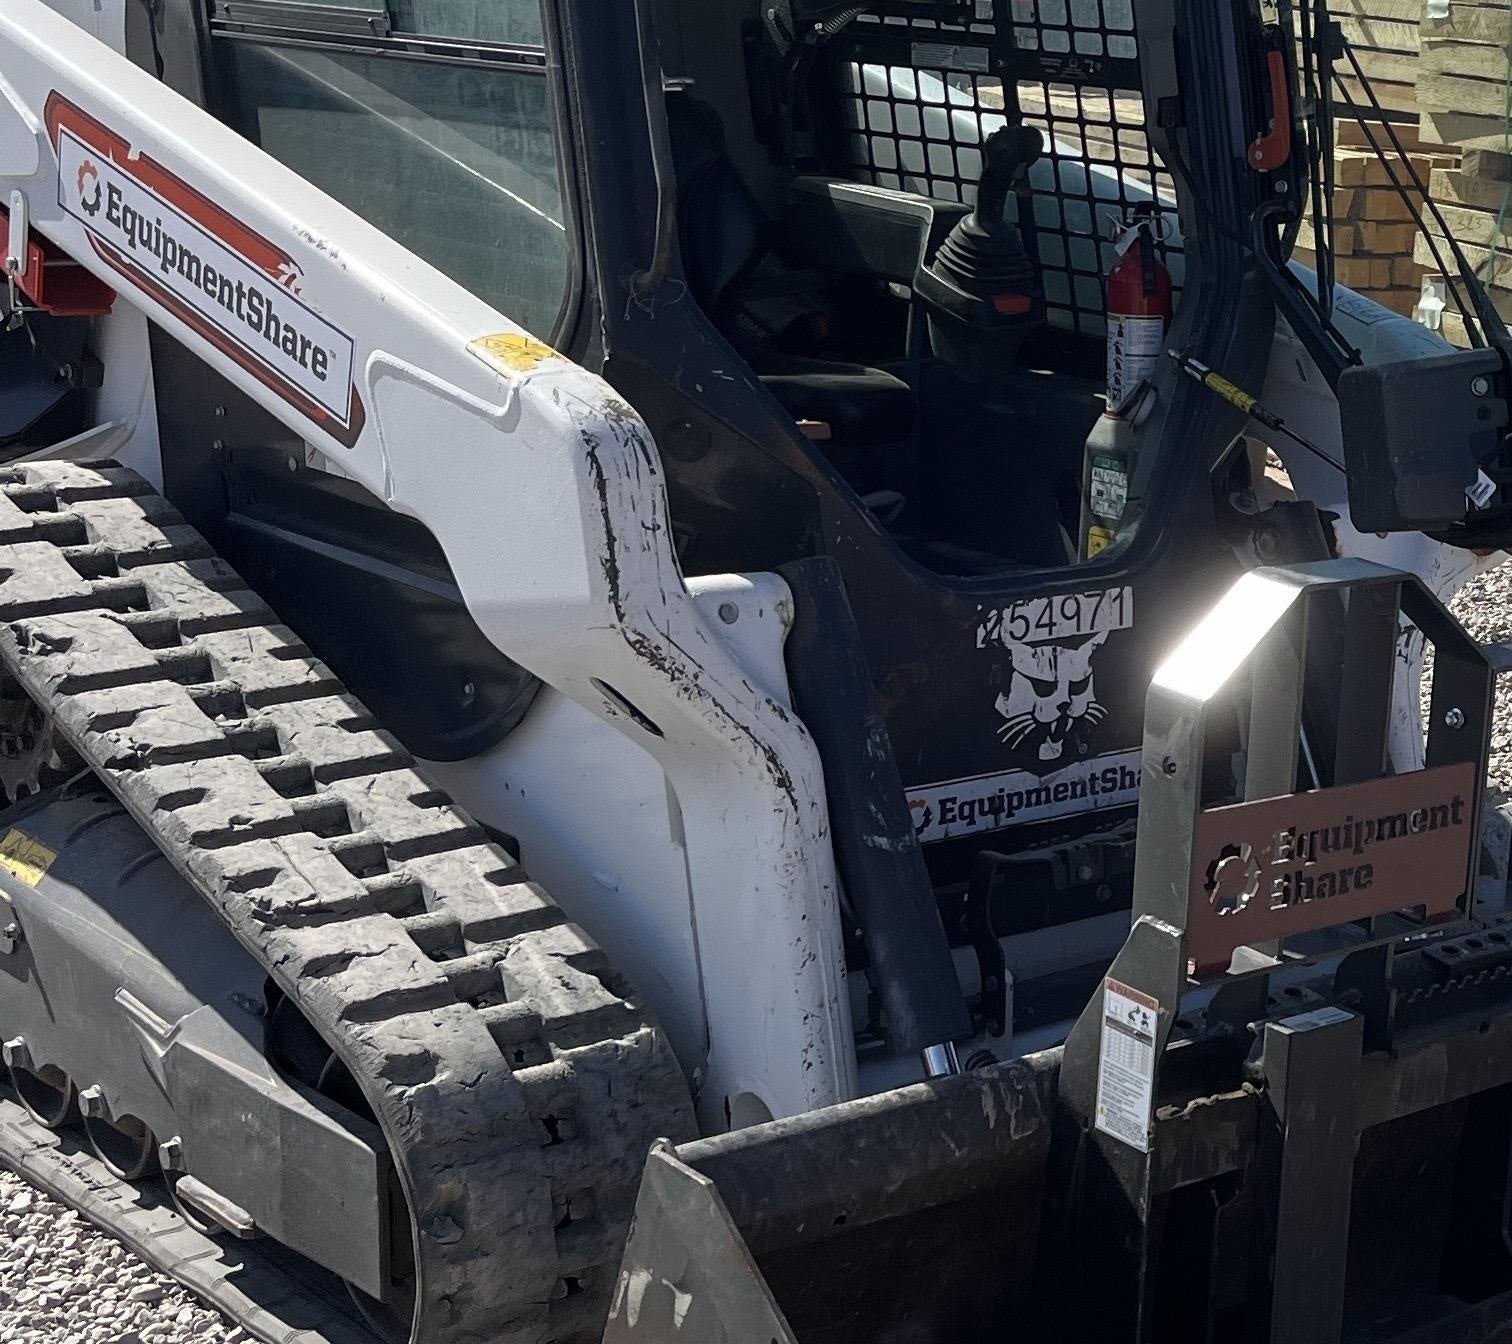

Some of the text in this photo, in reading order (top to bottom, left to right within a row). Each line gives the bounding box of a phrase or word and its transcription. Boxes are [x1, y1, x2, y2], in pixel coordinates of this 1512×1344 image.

[105, 180, 328, 382] EquipmentShare
[1271, 795, 1464, 866] Equipment
[1270, 863, 1375, 911] Share
